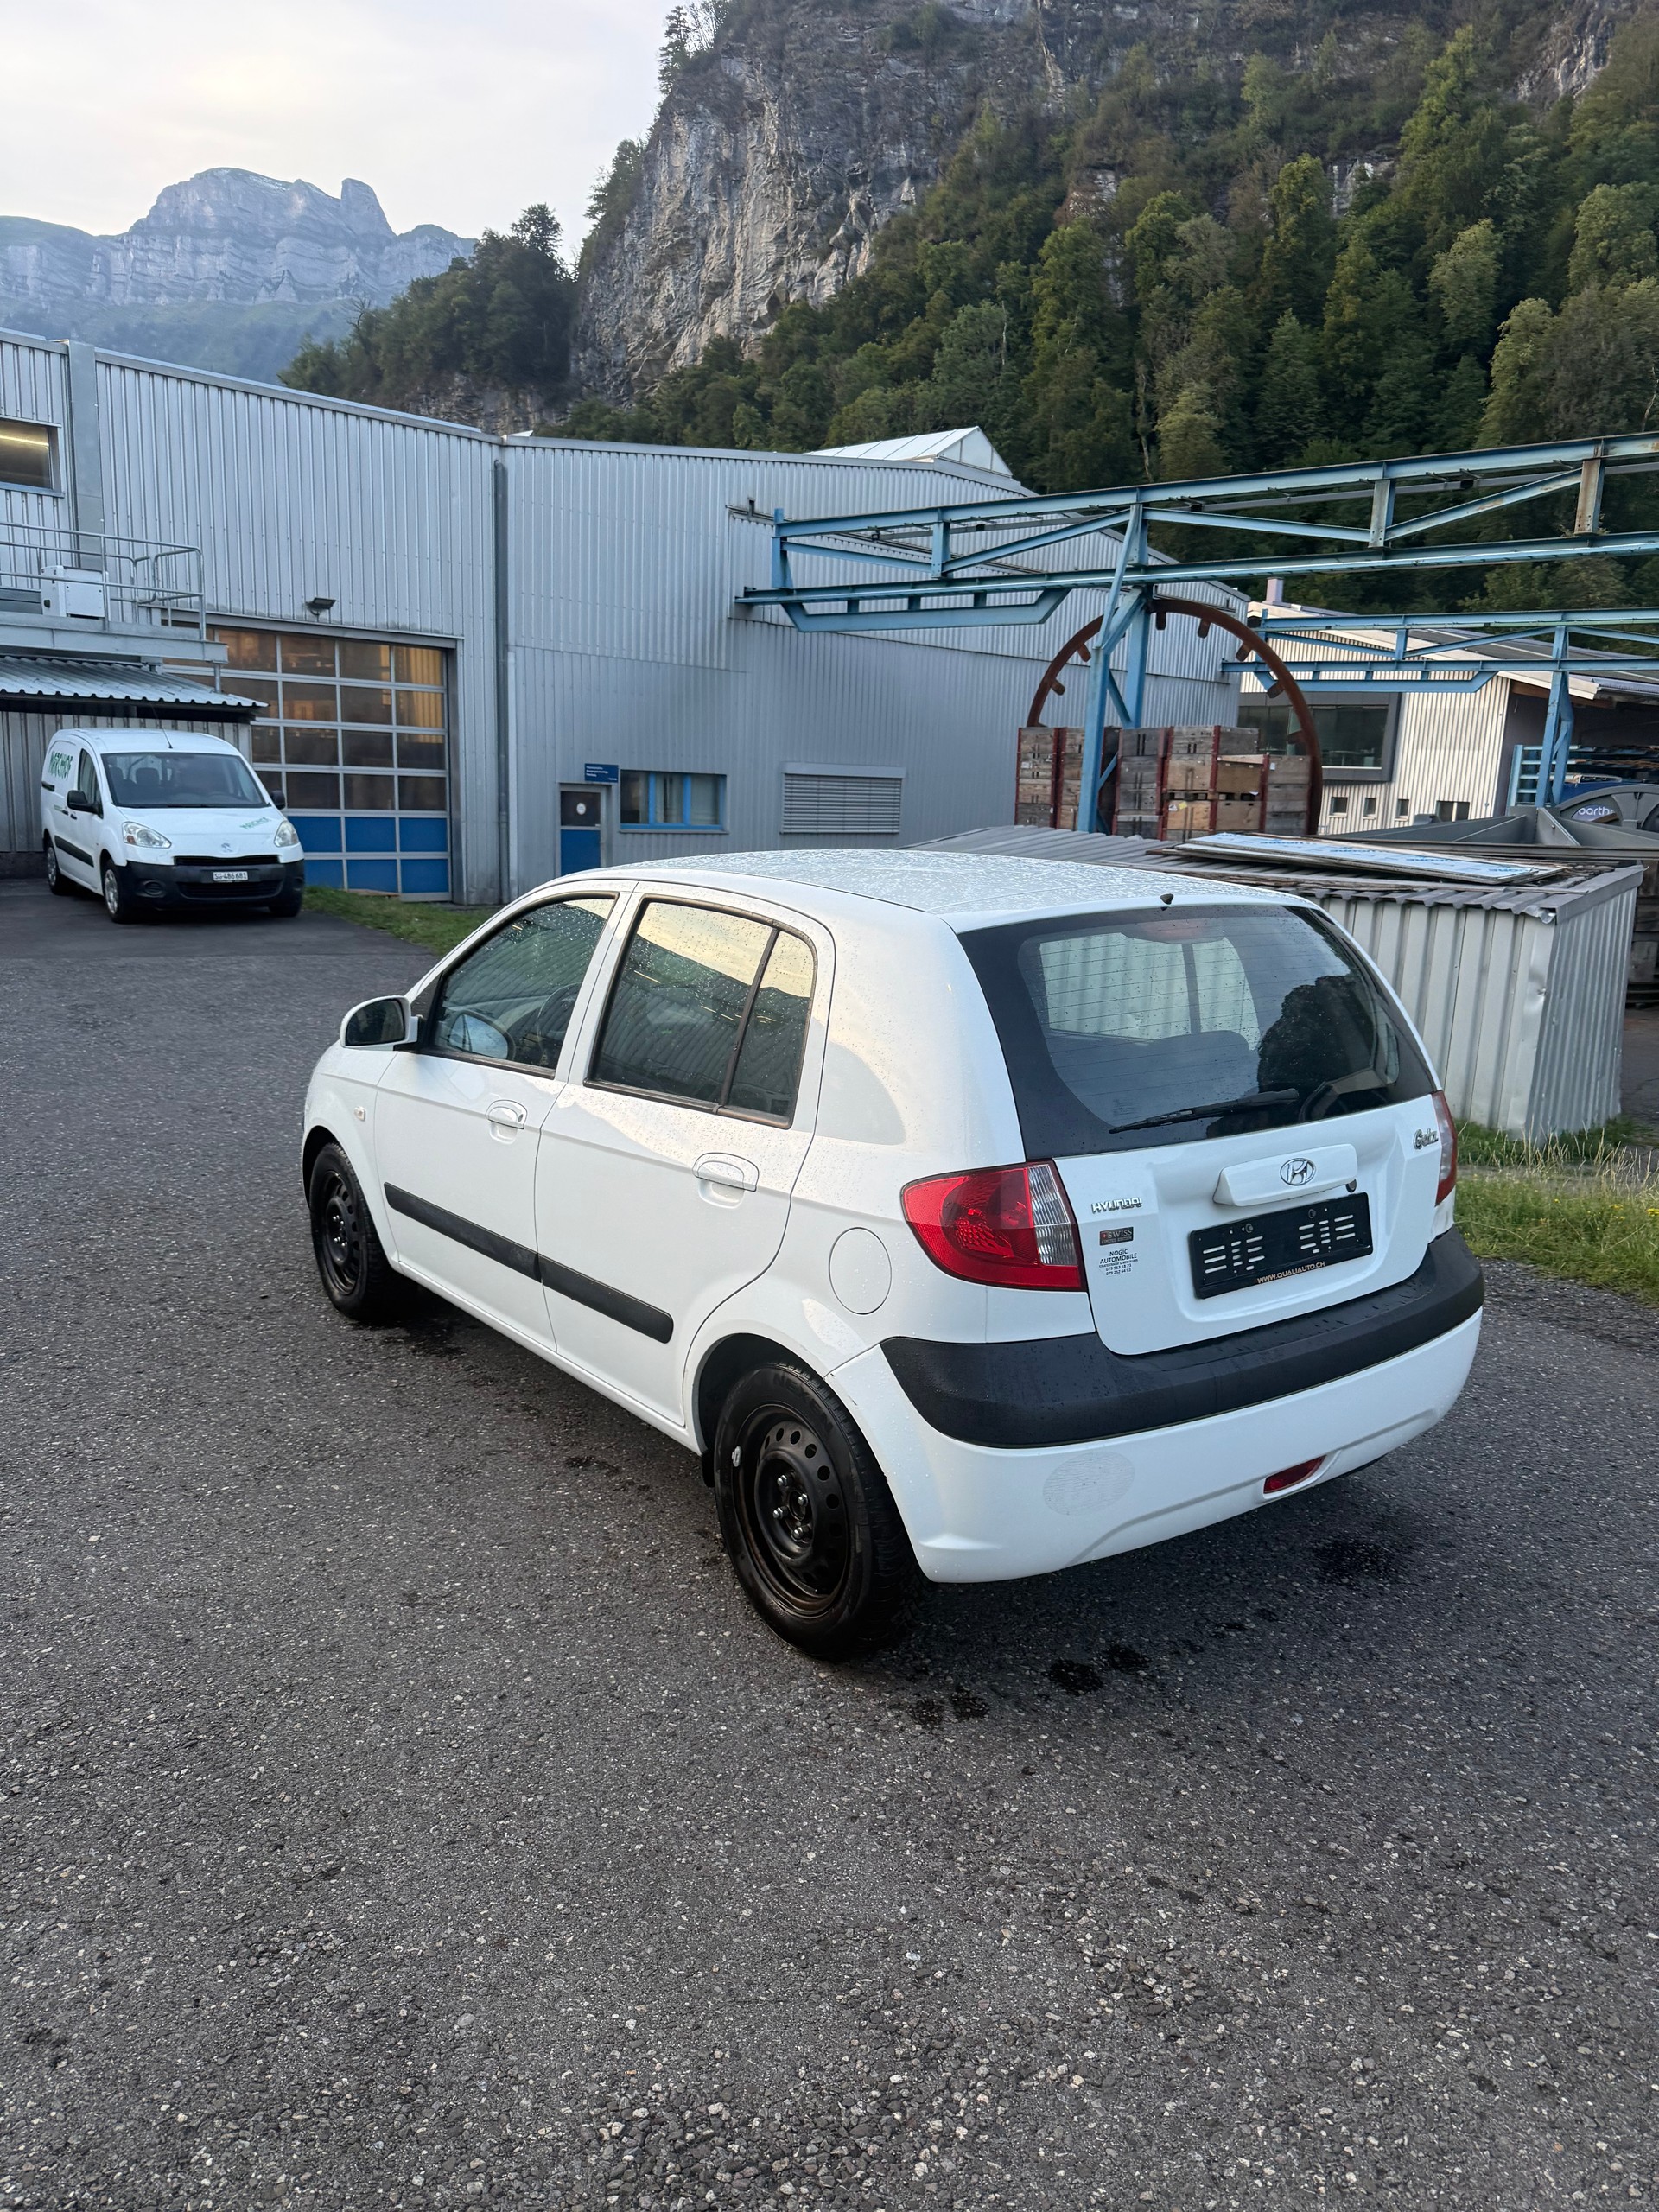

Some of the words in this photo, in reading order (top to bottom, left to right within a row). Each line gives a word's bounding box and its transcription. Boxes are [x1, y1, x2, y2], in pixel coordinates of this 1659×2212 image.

[1108, 1229, 1133, 1239] SWISS
[1109, 1249, 1128, 1257] NOGIC
[1099, 1253, 1138, 1264] AUTOMOBILE
[1257, 1261, 1325, 1284] WWW.QUALIAUTO.CH
